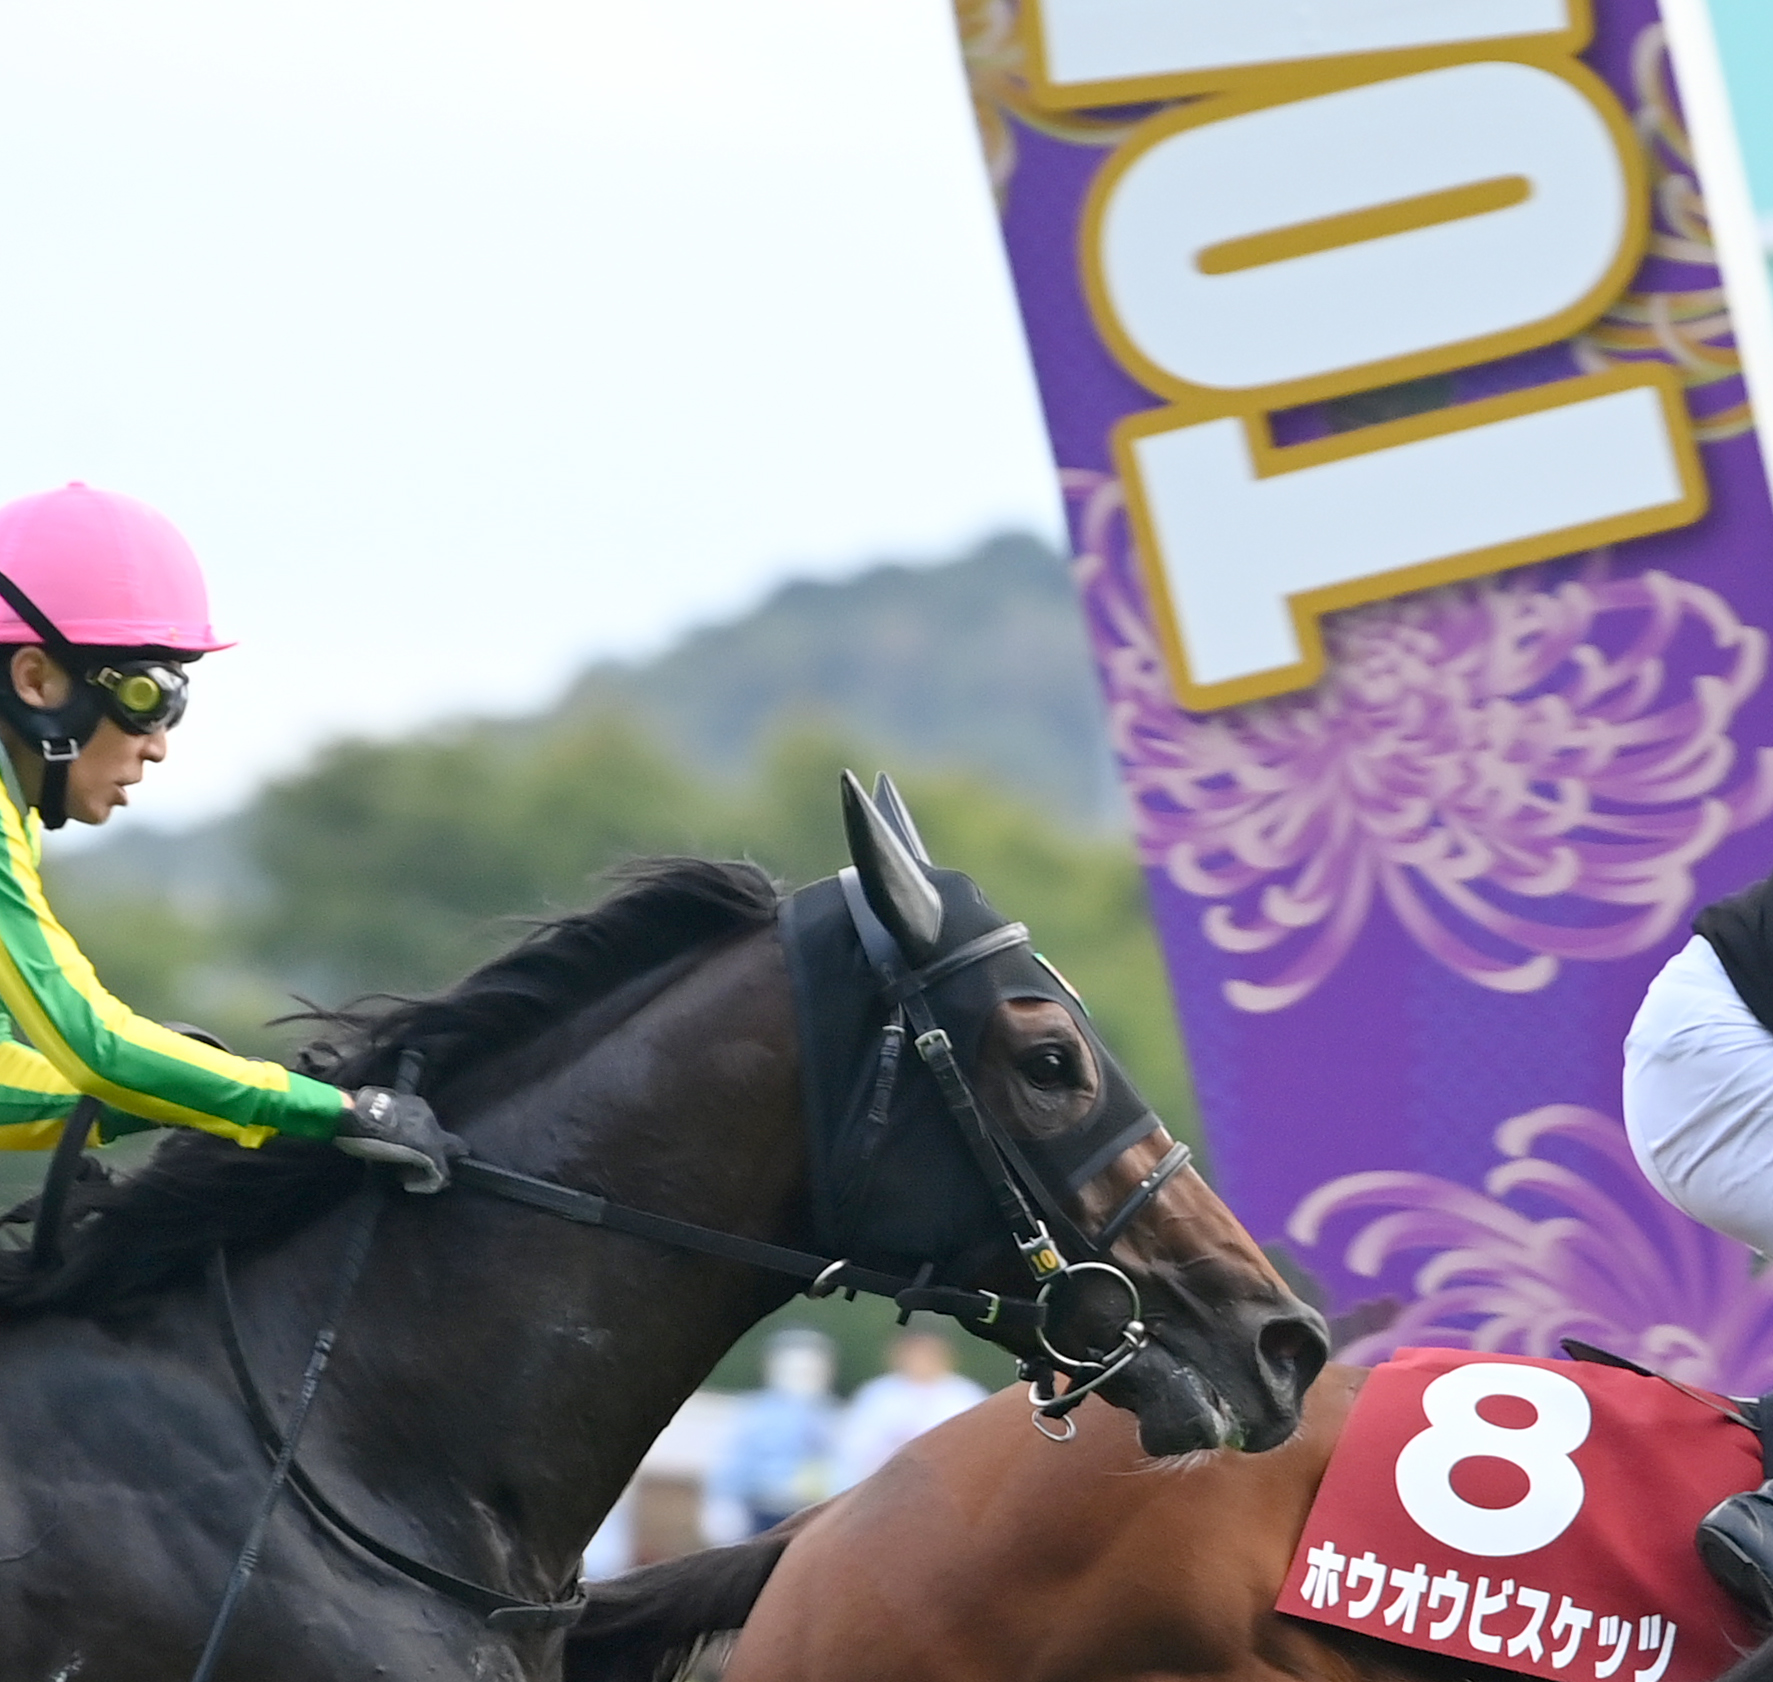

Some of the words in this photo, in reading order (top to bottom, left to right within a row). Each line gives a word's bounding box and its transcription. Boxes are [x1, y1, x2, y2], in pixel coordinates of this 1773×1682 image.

[1022, 0, 1708, 712] TO
[1031, 1249, 1057, 1273] 10
[1395, 1362, 1592, 1557] 8
